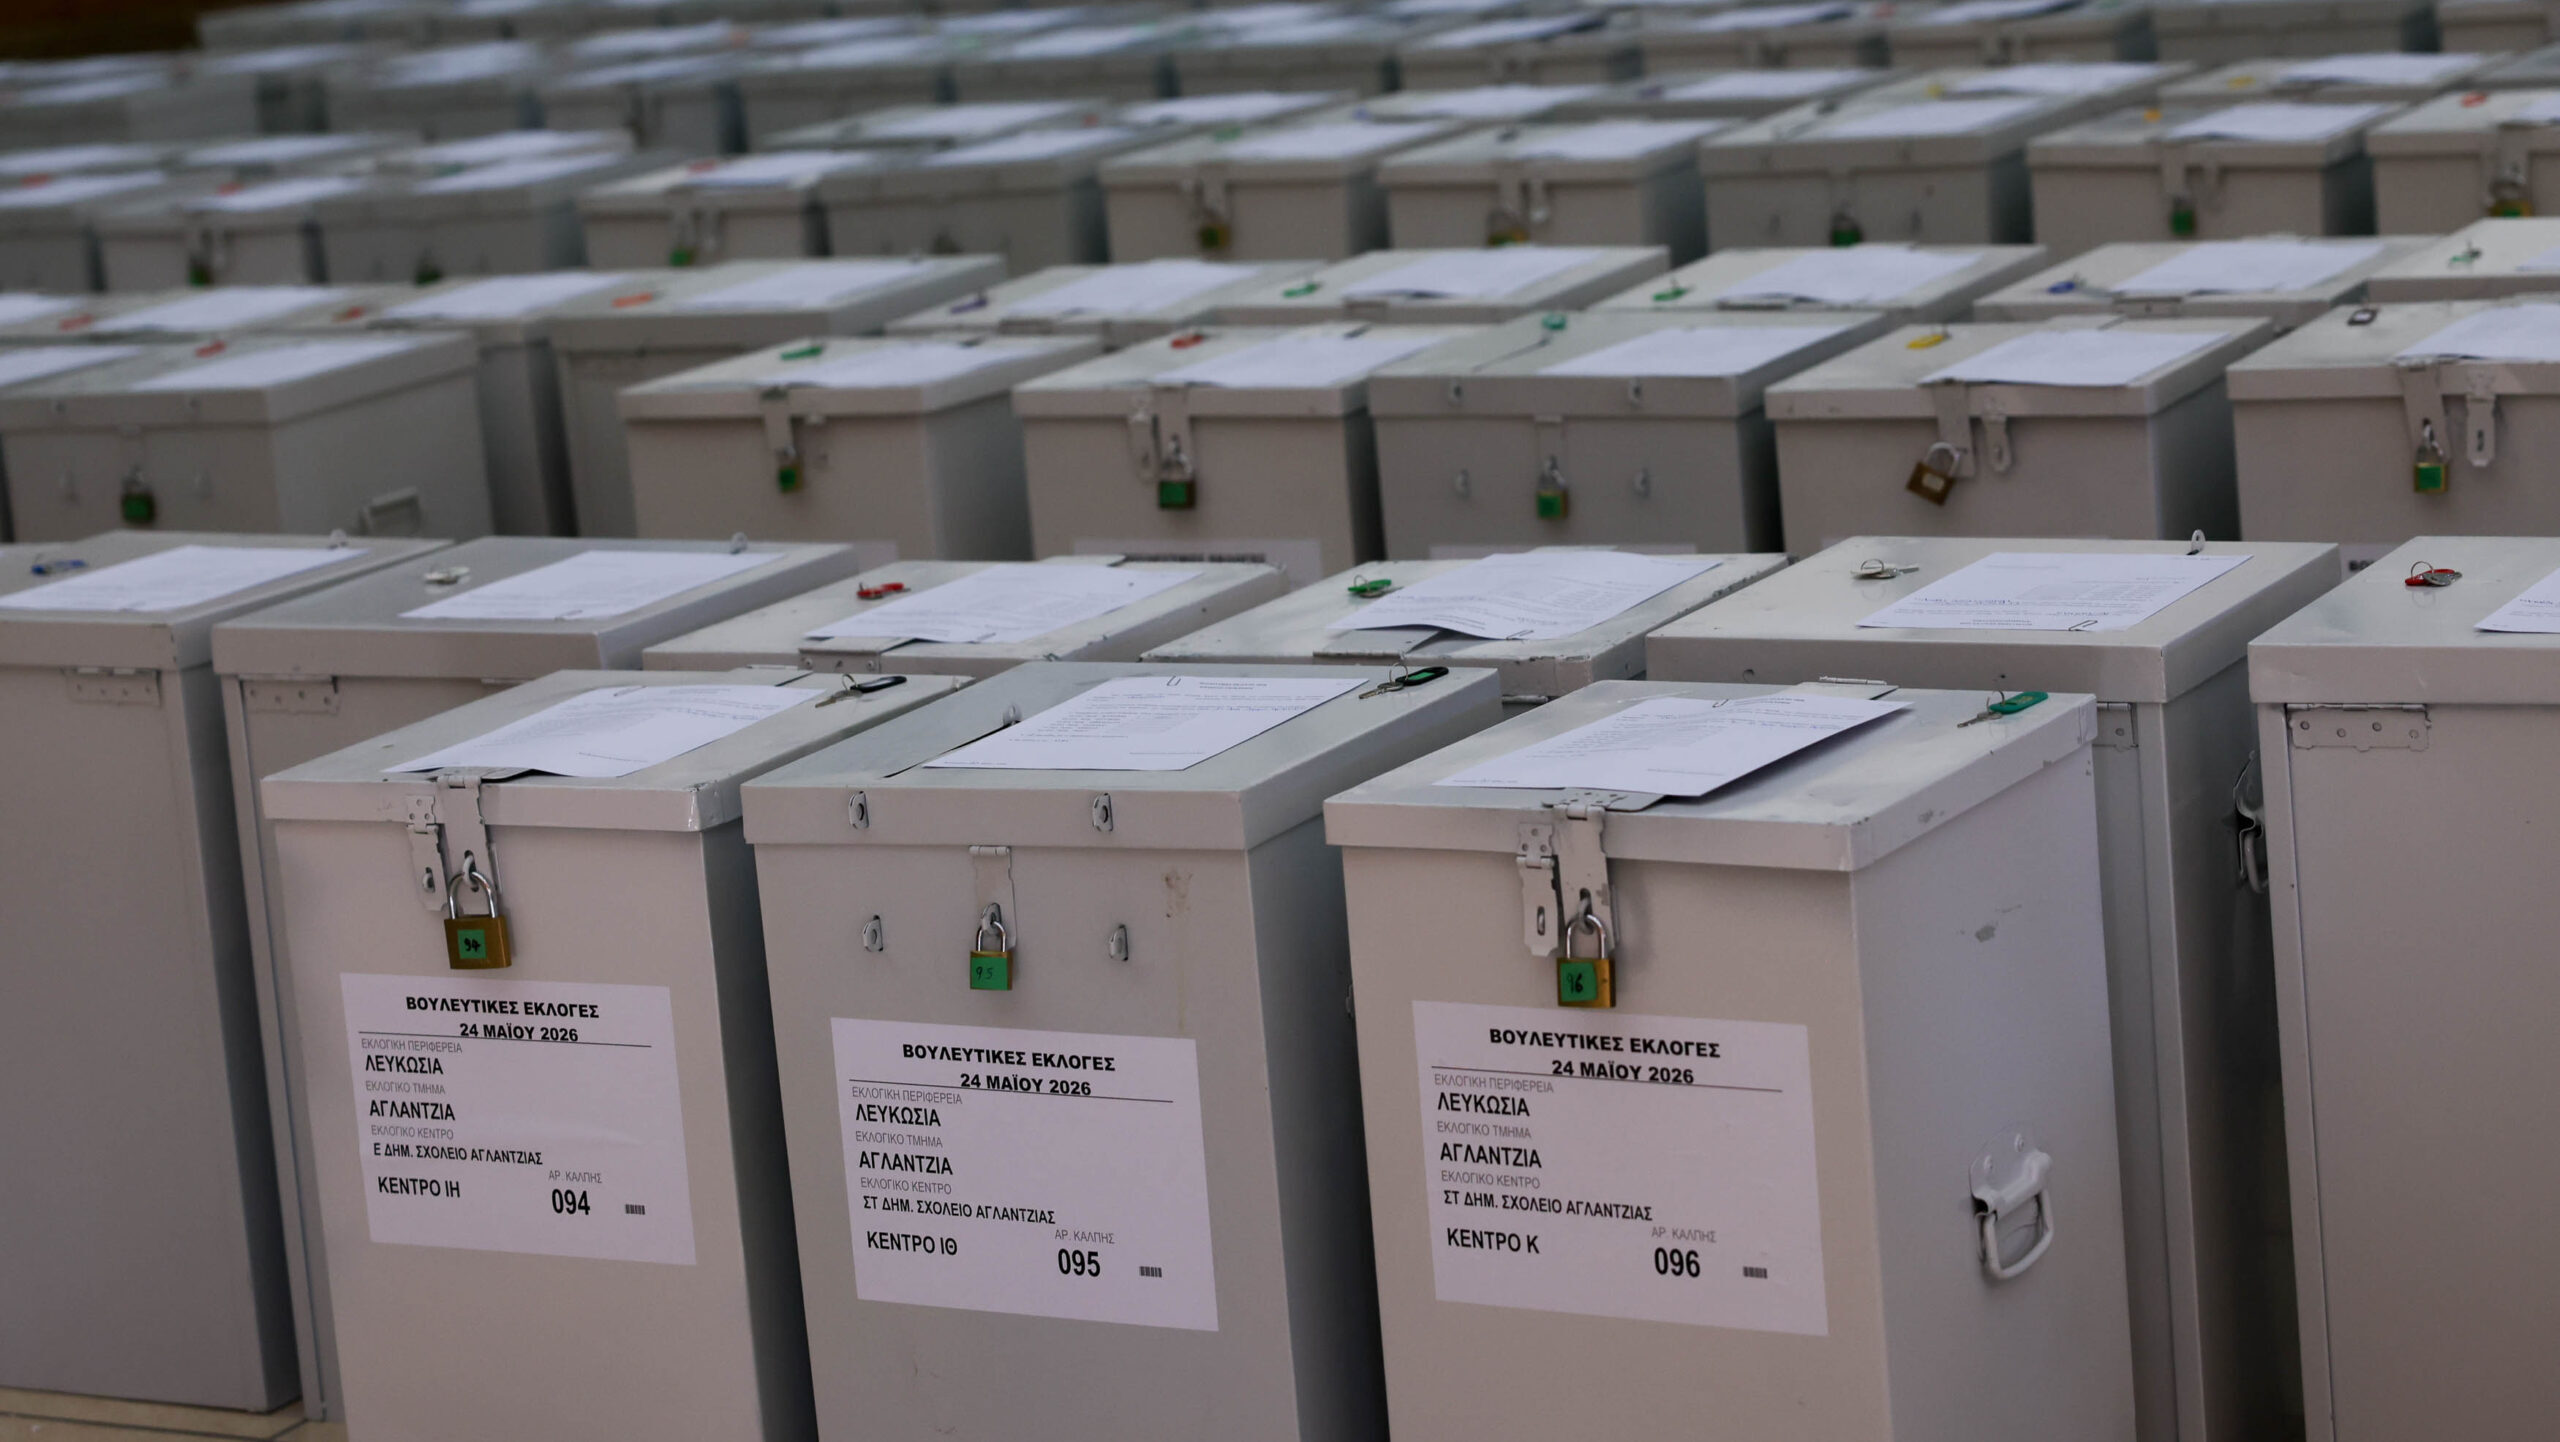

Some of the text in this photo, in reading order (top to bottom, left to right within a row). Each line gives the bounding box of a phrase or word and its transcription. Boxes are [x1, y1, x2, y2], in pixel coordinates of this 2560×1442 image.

[406, 996, 599, 1018] ΒΟΥΛΕΥΤΙΚΕΣ ΕΚΛΟΓΕΣ
[460, 1022, 578, 1042] 24 ΜΑΪΟΥ 2026
[361, 1038, 463, 1053] ΕΚΛΟΓΙΚΗ ΠΕΡΙΦΕΡΕΙΑ
[1490, 1029, 1720, 1058] ΒΟΥΛΕΥΤΙΚΕΣ ΕΚΛΟΓΕΣ
[365, 1054, 444, 1075] ΛΕΥΚΩΣΙΑ
[903, 1044, 1115, 1071] ΒΟΥΛΕΥΤΙΚΕΣ ΕΚΛΟΓΕΣ
[1434, 1073, 1554, 1093] ΕΚΛΟΓΙΚΗ ΠΕΡΙΦΕΡΕΙΑ
[1551, 1060, 1694, 1084] 24 ΜΑΪΟΥ 2026
[365, 1080, 446, 1094] ΕΚΛΟΓΙΚΟ ΤΜΗΜΑ
[852, 1086, 963, 1104] ΕΚΛΟΓΙΚΗ ΠΕΡΙΦΕΡΕΙΑ
[960, 1073, 1091, 1096] 24 ΜΑΪΟΥ 2026
[369, 1100, 455, 1121] ΑΓΛΑΝΤΖΙΑ
[856, 1103, 941, 1127] ΛΕΥΚΩΣΙΑ
[1438, 1092, 1530, 1117] ΛΕΥΚΩΣΙΑ
[371, 1124, 454, 1141] ΕΚΛΟΓΙΚΟ ΚΕΝΤΡΟ
[855, 1130, 943, 1148] ΕΚΛΟΓΙΚΟ ΤΜΗΜΑ
[1437, 1120, 1532, 1139] ΕΚΛΟΓΙΚΟ ΤΜΗΜΑ
[373, 1142, 543, 1165] Ε ΔΗΜ. ΣΧΟΛΕΙΟ ΑΓΛΑΝΤΖΙΑΣ
[859, 1151, 953, 1175] ΑΓΛΑΝΤΖΙΑ
[1440, 1142, 1542, 1168] ΑΓΛΑΝΤΖΙΑ
[378, 1176, 460, 1198] ΚΕΝΤΡΟ ΙΗ
[565, 1171, 602, 1184] ΚΑΛΠΗΣ
[860, 1177, 952, 1195] ΕΚΛΟΓΙΚΟ ΚΕΝΤΡΟ
[1441, 1170, 1541, 1189] ΕΚΛΟΓΙΚΟ ΚΕΝΤΡΟ
[552, 1189, 590, 1215] 094
[863, 1195, 1056, 1224] ΣΤ ΔΗΜ. ΣΧΟΛΕΙΟ ΑΓΛΑΝΤΖΙΑΣ
[1444, 1190, 1653, 1221] ΣΤ ΔΗΜ. ΣΧΟΛΕΙΟ ΑΓΛΑΝΤΖΙΑΣ
[867, 1231, 957, 1256] ΚΕΝΤΡΟ ΙΘ
[1073, 1230, 1115, 1244] ΚΑΛΠΗΣ
[1447, 1228, 1540, 1254] ΚΕΝΤΡΟ Κ
[1672, 1228, 1716, 1243] ΚΑΛΠΗΣ
[1058, 1248, 1100, 1277] 095
[1654, 1247, 1700, 1278] 096
